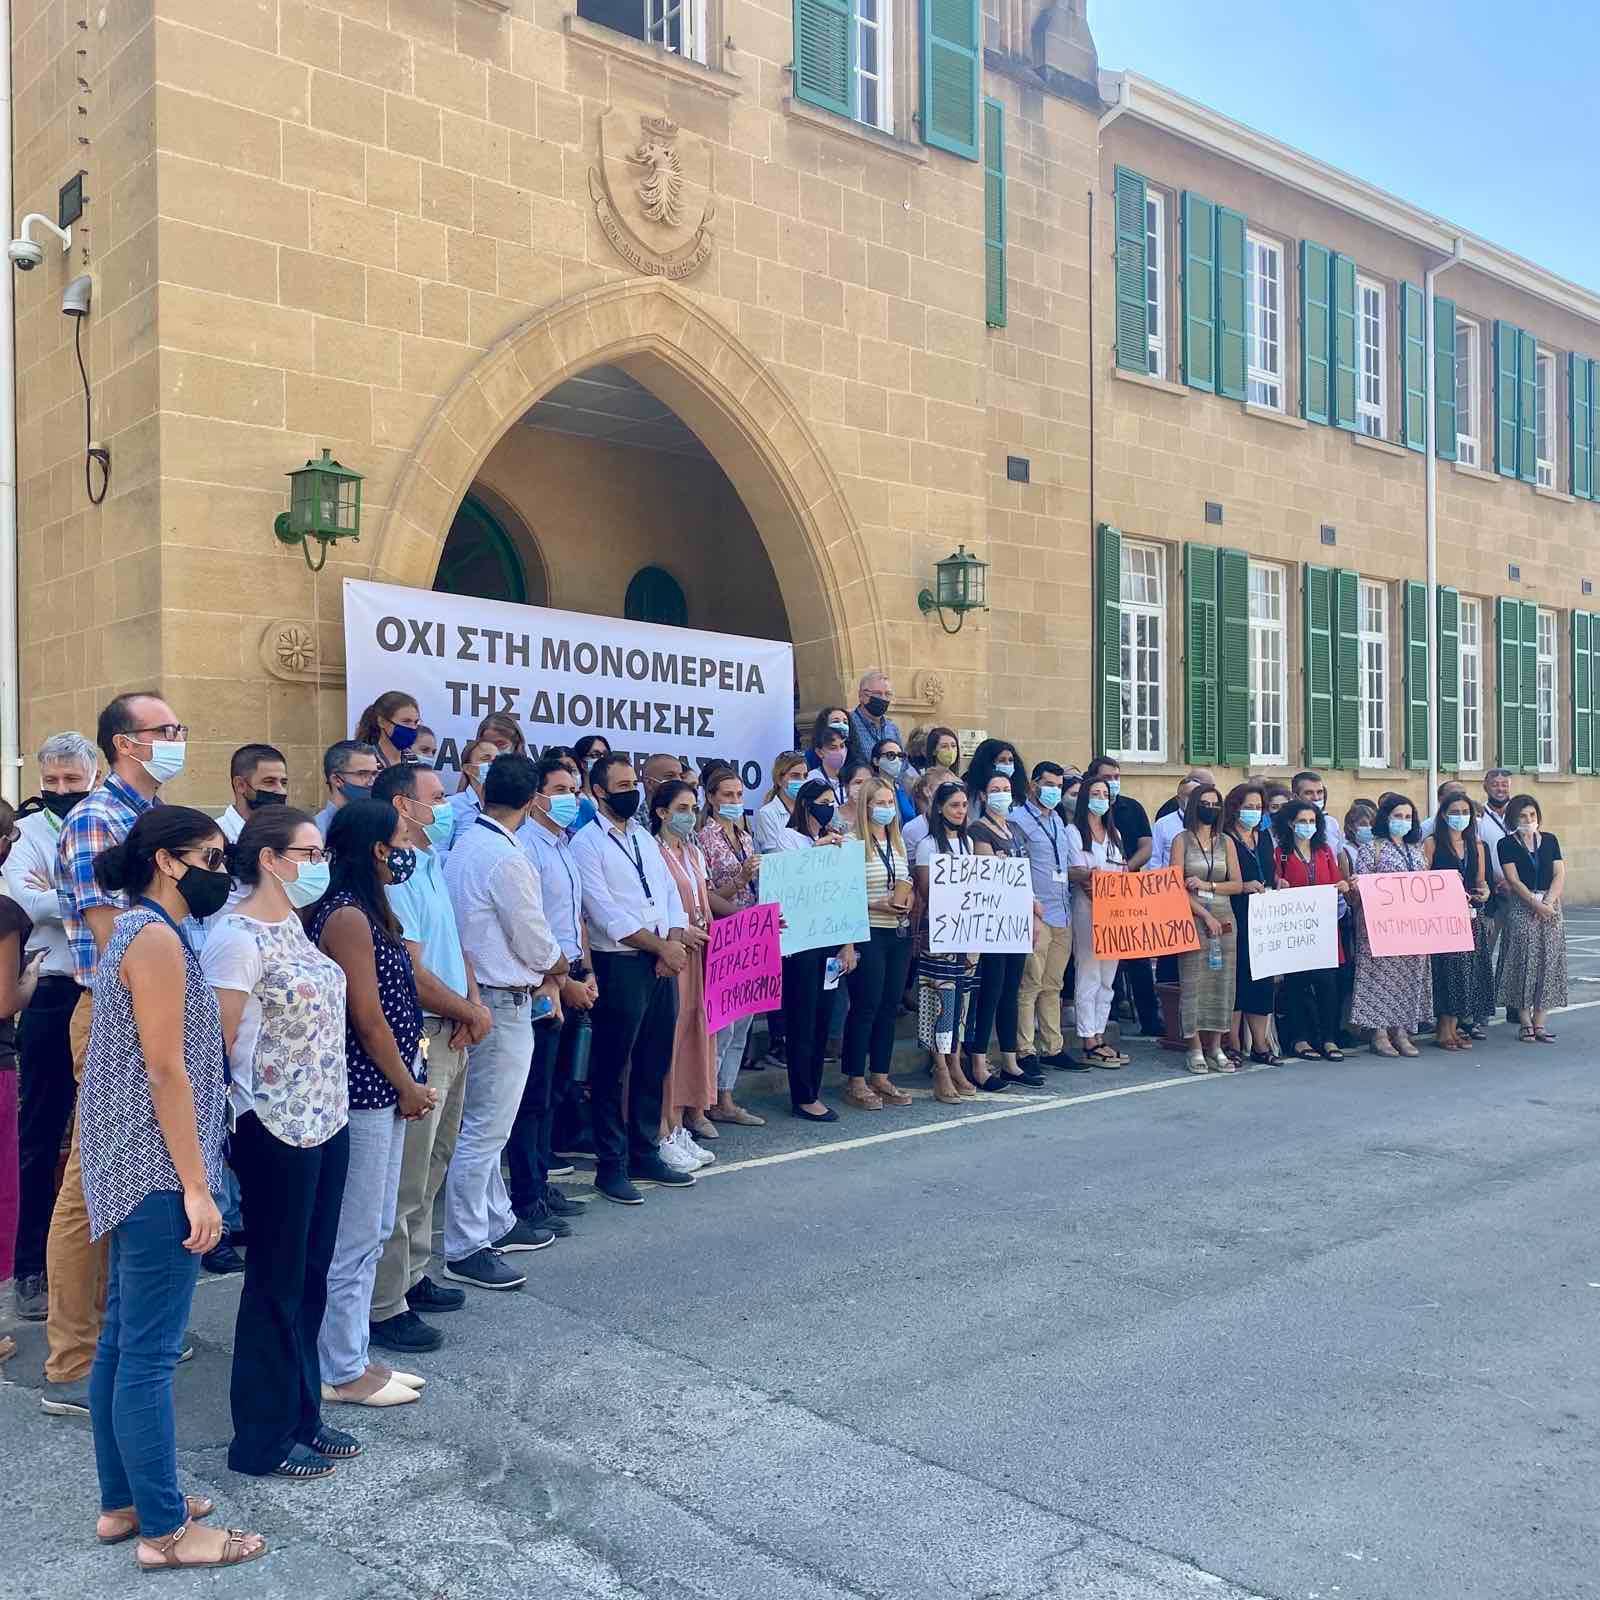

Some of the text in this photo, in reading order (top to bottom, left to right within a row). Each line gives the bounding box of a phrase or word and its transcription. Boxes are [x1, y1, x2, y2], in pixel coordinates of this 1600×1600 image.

[376, 616, 766, 694] ΟΧΙ ΣΤΗ ΜΟΝΟΜΕΡΕΙΑ
[445, 680, 715, 738] ΤΗΣ ΔΙΟΙΚΗΣΗΣ
[934, 857, 1027, 887] ΣΕΒΑΣΜΟΣ
[1119, 874, 1133, 897] ΤΑ
[1136, 870, 1181, 898] ΧΕΡΙΑ
[960, 891, 1002, 911] ΣΤΗΝ
[1375, 874, 1445, 906] STOP
[1252, 900, 1317, 919] WITHDRAW
[711, 917, 747, 954] ΔΕΝ
[749, 909, 774, 938] ΘΑ
[932, 913, 1030, 943] ΣΥΝΤΕΧΝΙΑ
[1093, 920, 1195, 954] ΣΥΝΔΙΚΑΛΙΣΜΟ
[1287, 933, 1316, 949] CHAIR
[1372, 916, 1469, 937] INTIMIDATION
[709, 944, 768, 985] ΠΕΡΑΣΕΙ
[706, 1005, 713, 1025] Ο
